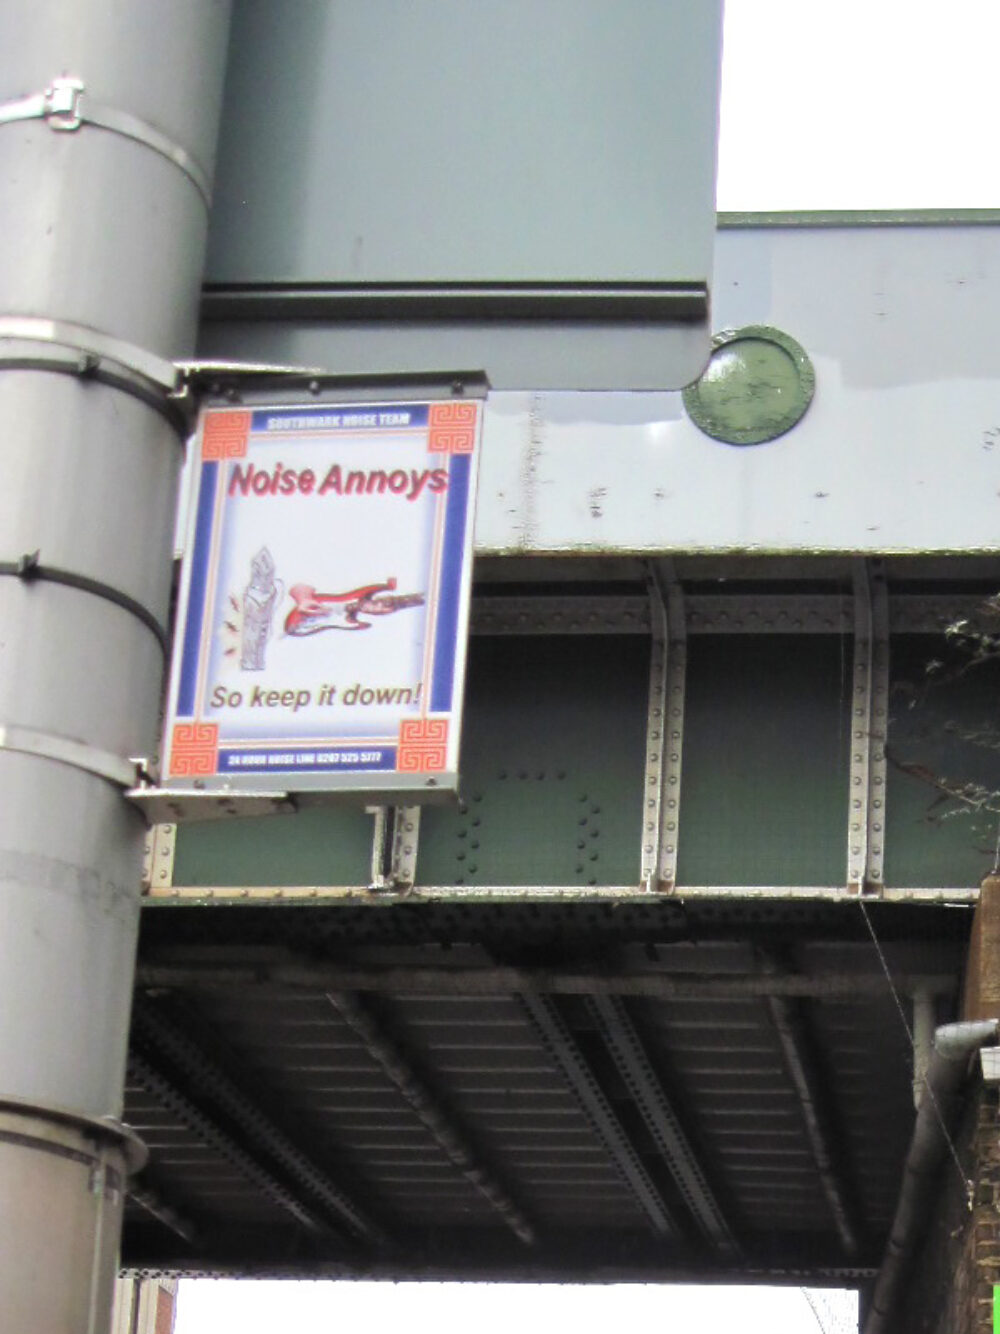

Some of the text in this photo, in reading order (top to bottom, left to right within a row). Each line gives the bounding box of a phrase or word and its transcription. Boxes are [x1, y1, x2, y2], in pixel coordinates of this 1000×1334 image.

[342, 413, 377, 428] NOISE
[379, 411, 411, 426] TEAM
[227, 462, 450, 502] Noise Annoys
[210, 682, 423, 713] So keep it down!
